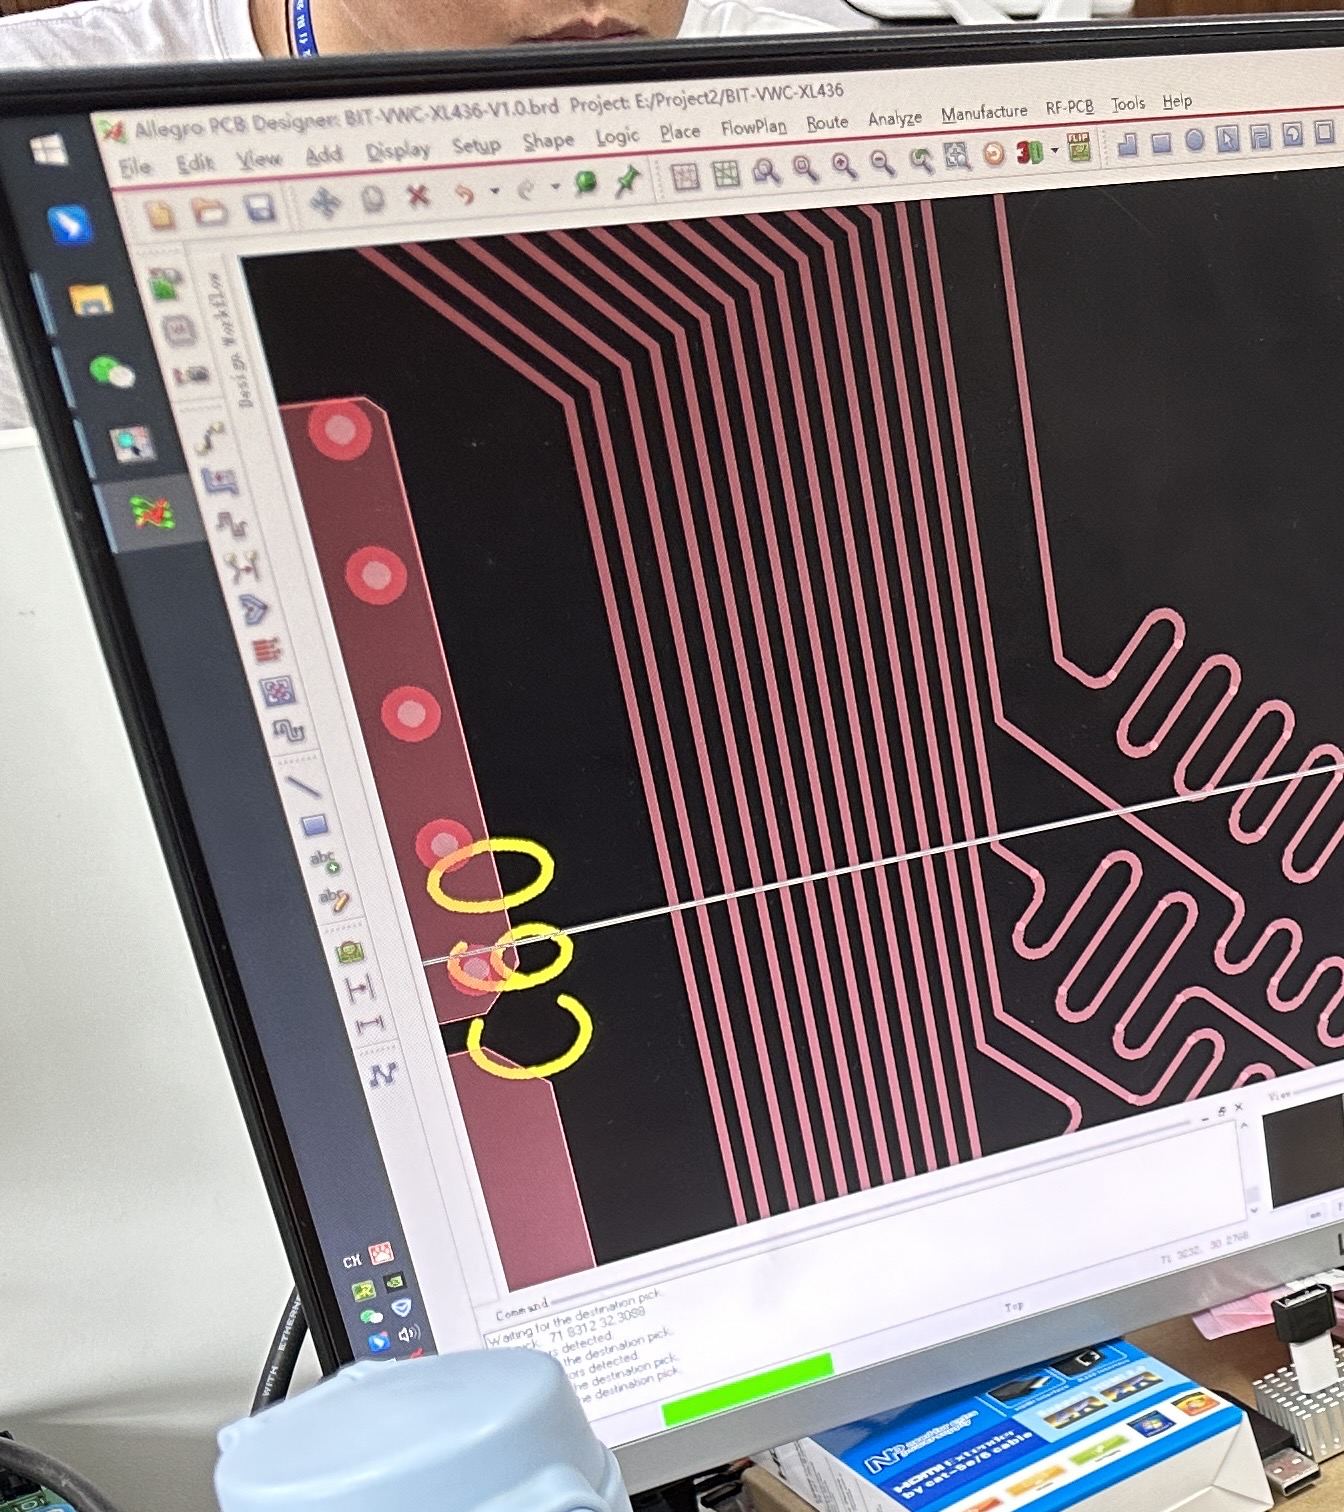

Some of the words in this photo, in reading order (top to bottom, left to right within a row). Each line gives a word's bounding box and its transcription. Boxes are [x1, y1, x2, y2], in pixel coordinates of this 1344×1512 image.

[119, 158, 152, 179] File
[176, 152, 215, 175] Edit
[236, 150, 283, 170] View
[305, 144, 344, 167] Add
[366, 139, 432, 163] Display
[452, 137, 502, 156] Setup
[522, 132, 576, 153] Shape
[596, 125, 641, 148] Logic
[660, 122, 701, 143] Place
[721, 117, 788, 136] FlowPlan
[807, 114, 850, 134] Route
[869, 109, 923, 129] Analyze
[941, 103, 1029, 125] Manufacture
[1046, 98, 1095, 115] RF-PCB
[1111, 95, 1147, 113] Tools
[1163, 92, 1193, 111] Help
[135, 120, 204, 141] Allegro
[209, 115, 247, 134] PCB
[426, 836, 594, 1081] C60
[902, 1484, 925, 1500] by
[992, 1430, 1034, 1454] cable
